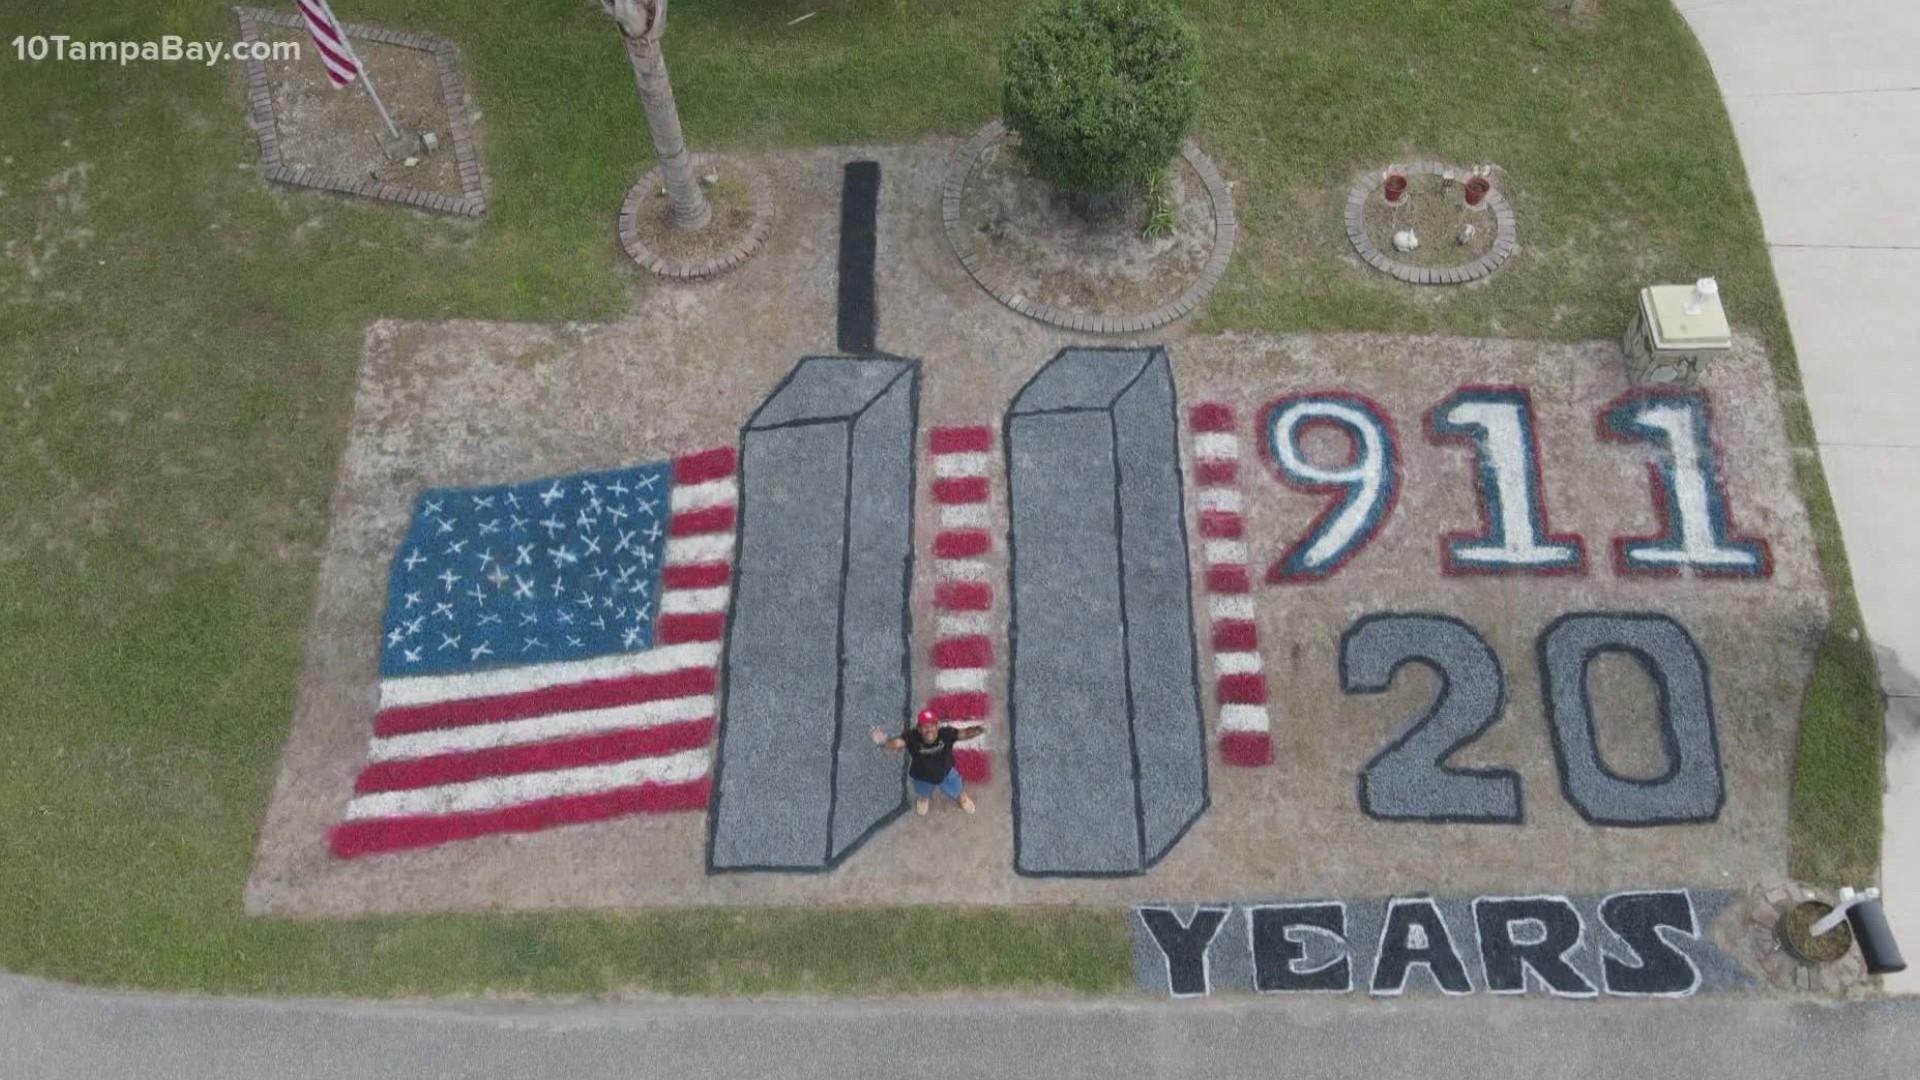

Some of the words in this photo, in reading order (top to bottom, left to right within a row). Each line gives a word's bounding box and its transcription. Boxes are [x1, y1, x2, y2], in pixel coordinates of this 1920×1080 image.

[1256, 384, 1774, 583] 911
[1338, 611, 1726, 827] 20
[1139, 888, 1702, 997] YEARS
